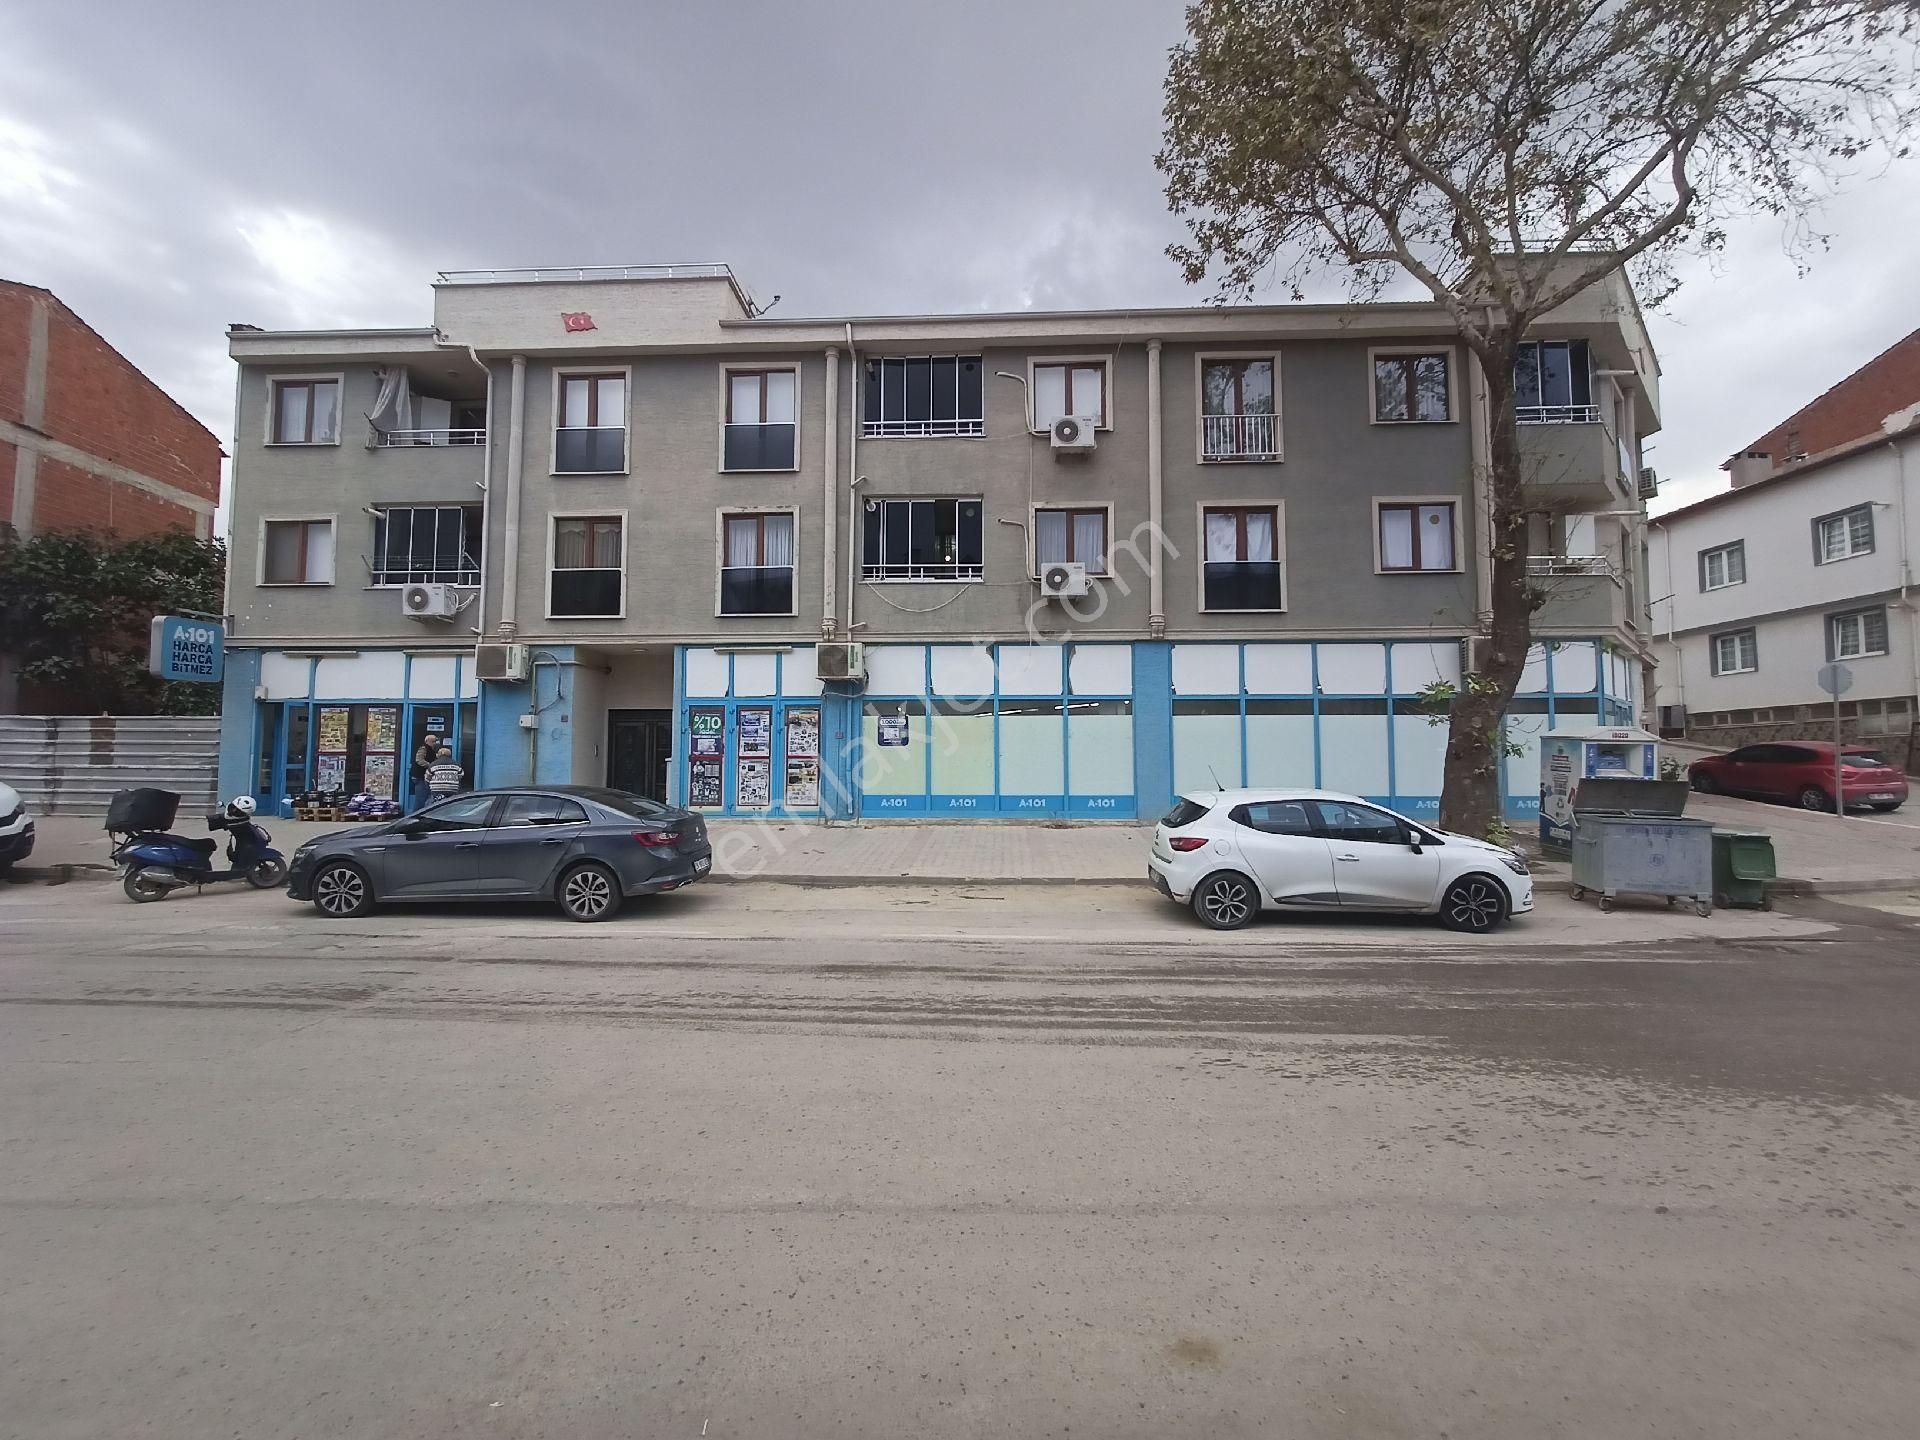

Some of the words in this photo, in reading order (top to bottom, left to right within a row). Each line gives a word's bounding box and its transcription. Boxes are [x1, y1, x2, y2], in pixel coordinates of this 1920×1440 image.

[173, 641, 213, 654] HARCA
[172, 652, 213, 664] HARCA
[694, 715, 722, 731] %10
